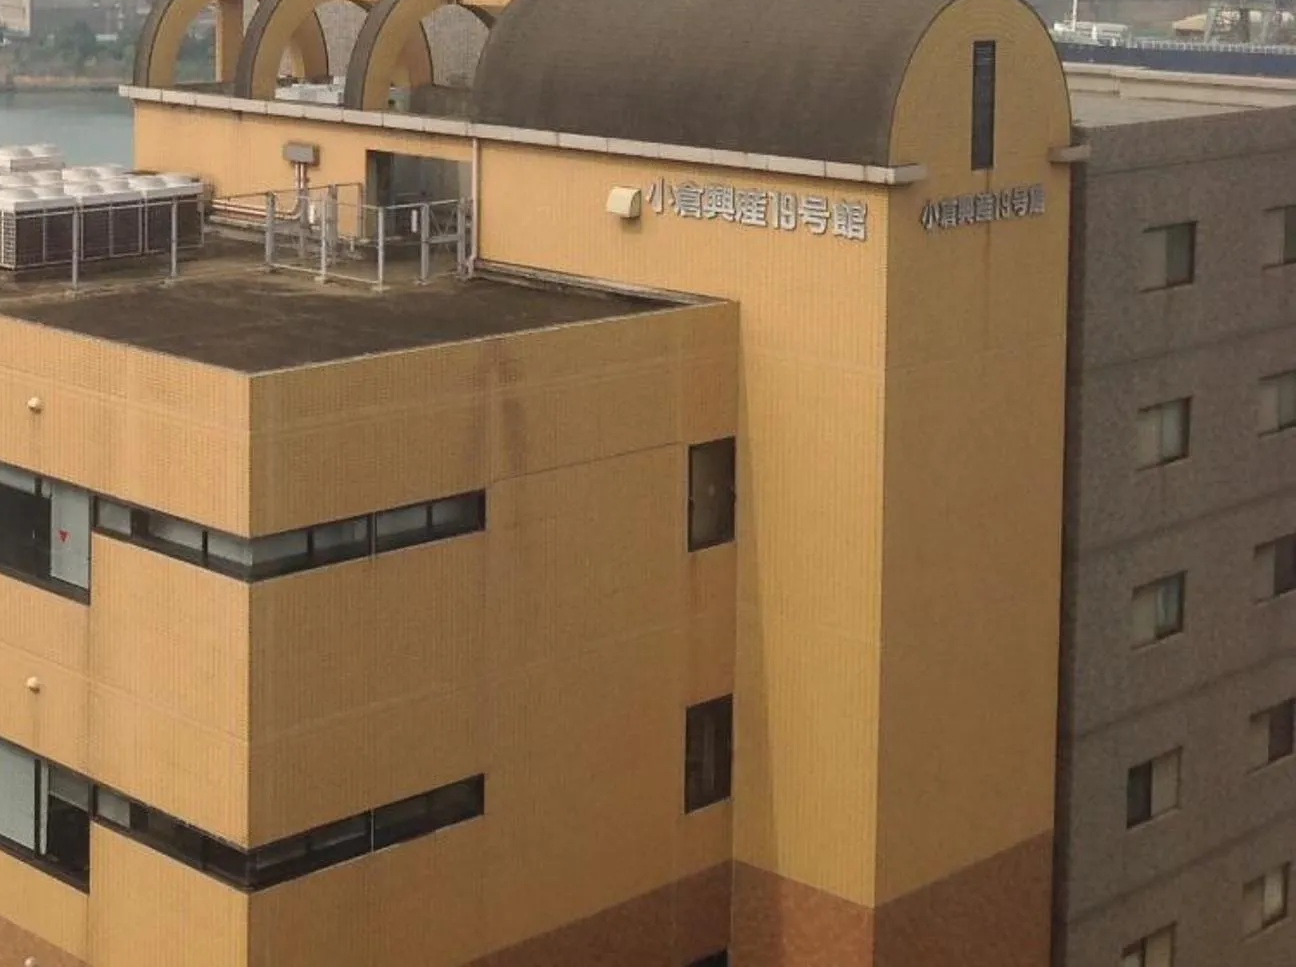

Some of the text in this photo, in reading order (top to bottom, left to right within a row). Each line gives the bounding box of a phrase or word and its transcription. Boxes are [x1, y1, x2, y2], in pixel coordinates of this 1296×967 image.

[645, 177, 867, 241] 小倉興産19号館
